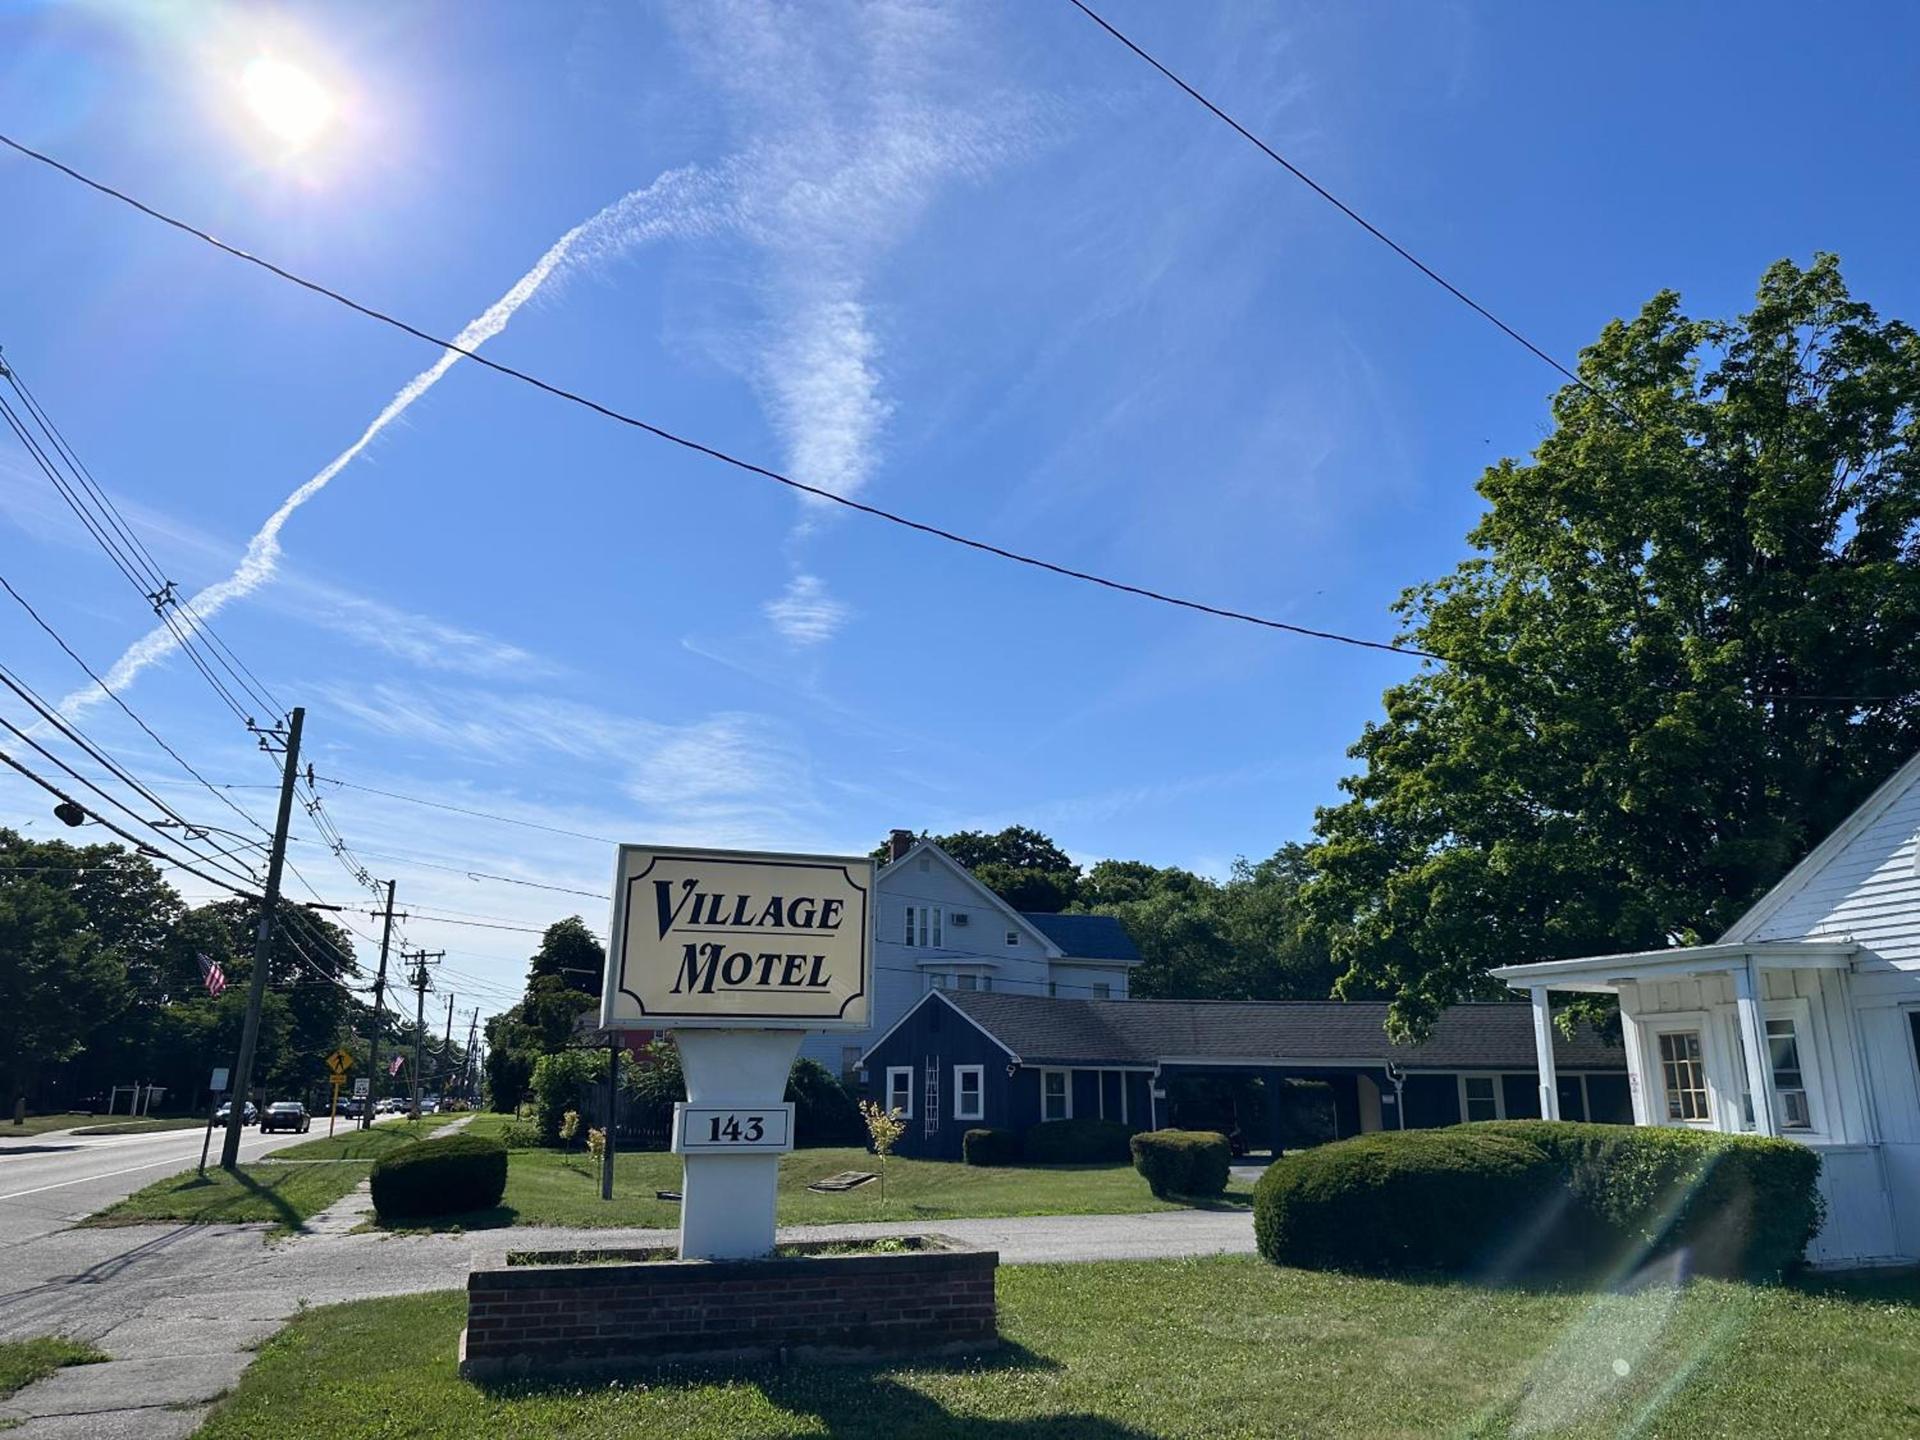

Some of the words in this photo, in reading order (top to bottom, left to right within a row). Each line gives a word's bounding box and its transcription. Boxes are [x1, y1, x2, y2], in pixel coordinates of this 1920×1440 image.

[653, 878, 844, 941] VILLAGE
[669, 942, 832, 994] MOTEL
[708, 1113, 764, 1142] 143
